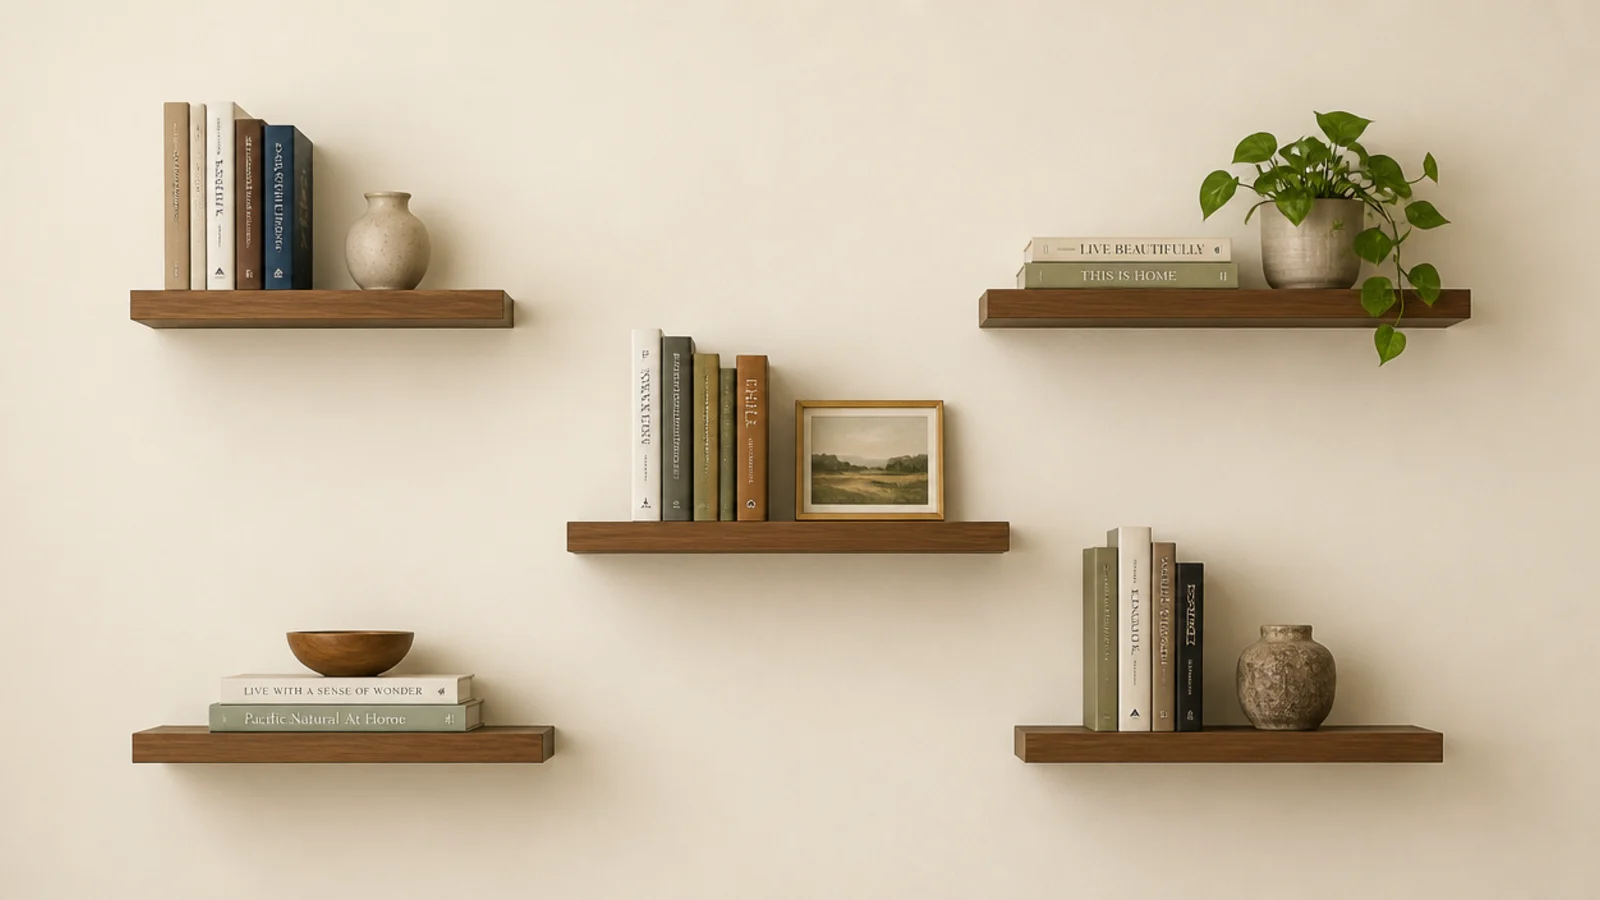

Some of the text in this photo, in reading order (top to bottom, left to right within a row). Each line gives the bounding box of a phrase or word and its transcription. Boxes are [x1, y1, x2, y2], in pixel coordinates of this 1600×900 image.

[1080, 243, 1205, 255] LIVE BEAUTIFULLY
[1081, 270, 1177, 281] THIS IS HOME
[244, 687, 423, 696] LIVE WITH A SENSE OF WONDER
[290, 712, 340, 725] Natural
[344, 712, 360, 725] At
